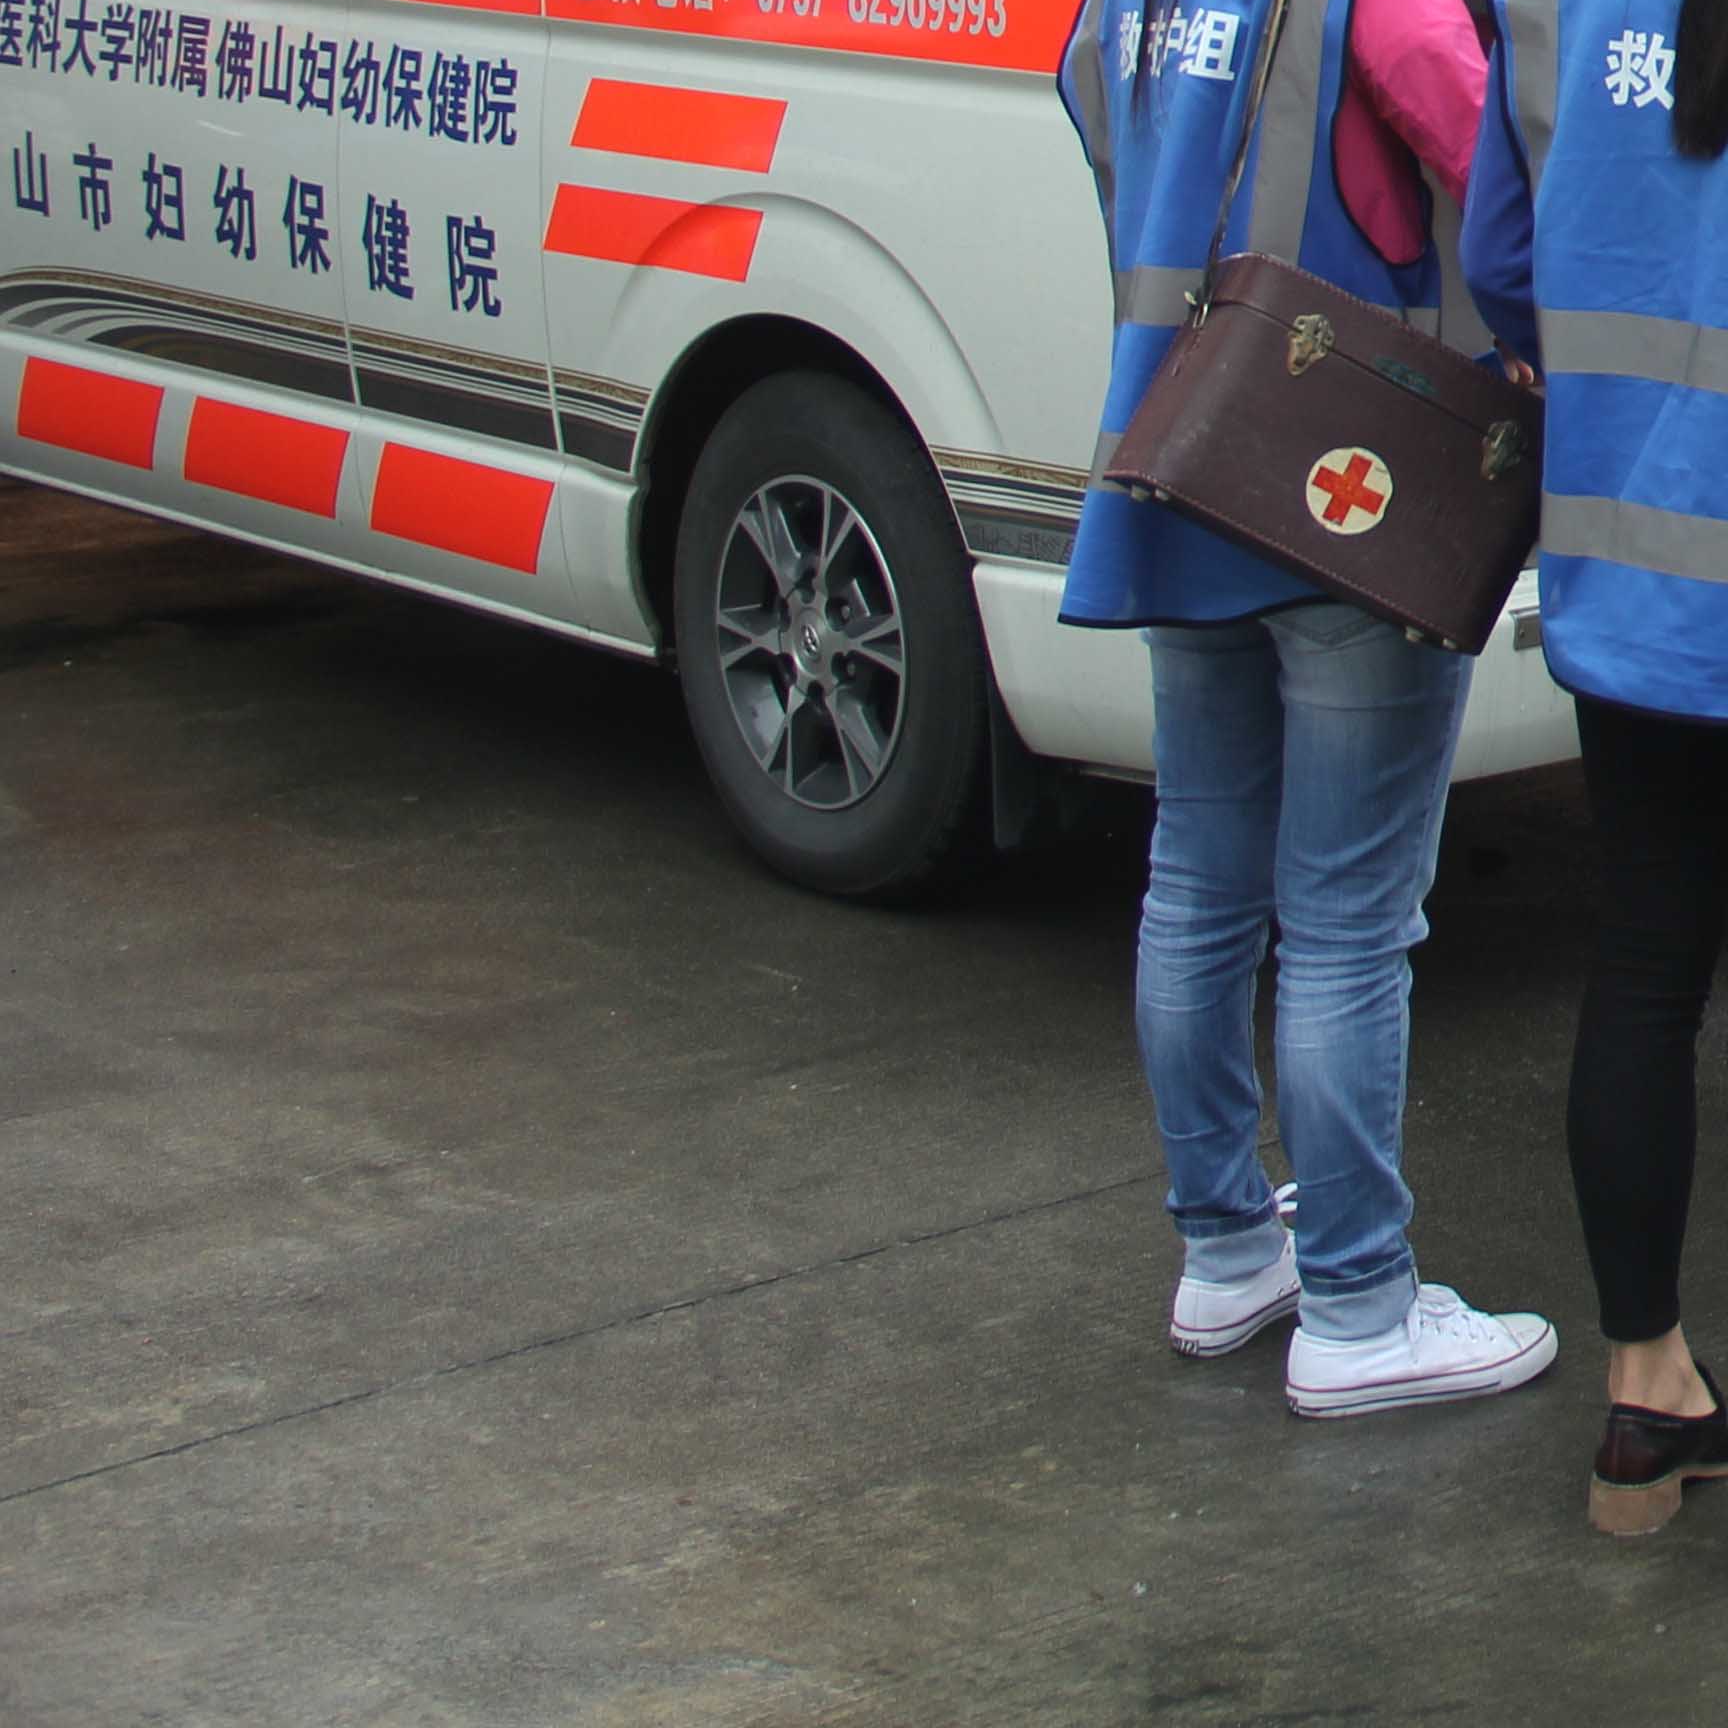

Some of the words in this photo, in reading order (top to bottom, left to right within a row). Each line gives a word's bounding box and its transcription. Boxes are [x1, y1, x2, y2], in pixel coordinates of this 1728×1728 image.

[13, 129, 502, 318] 山市妇幼保健院
